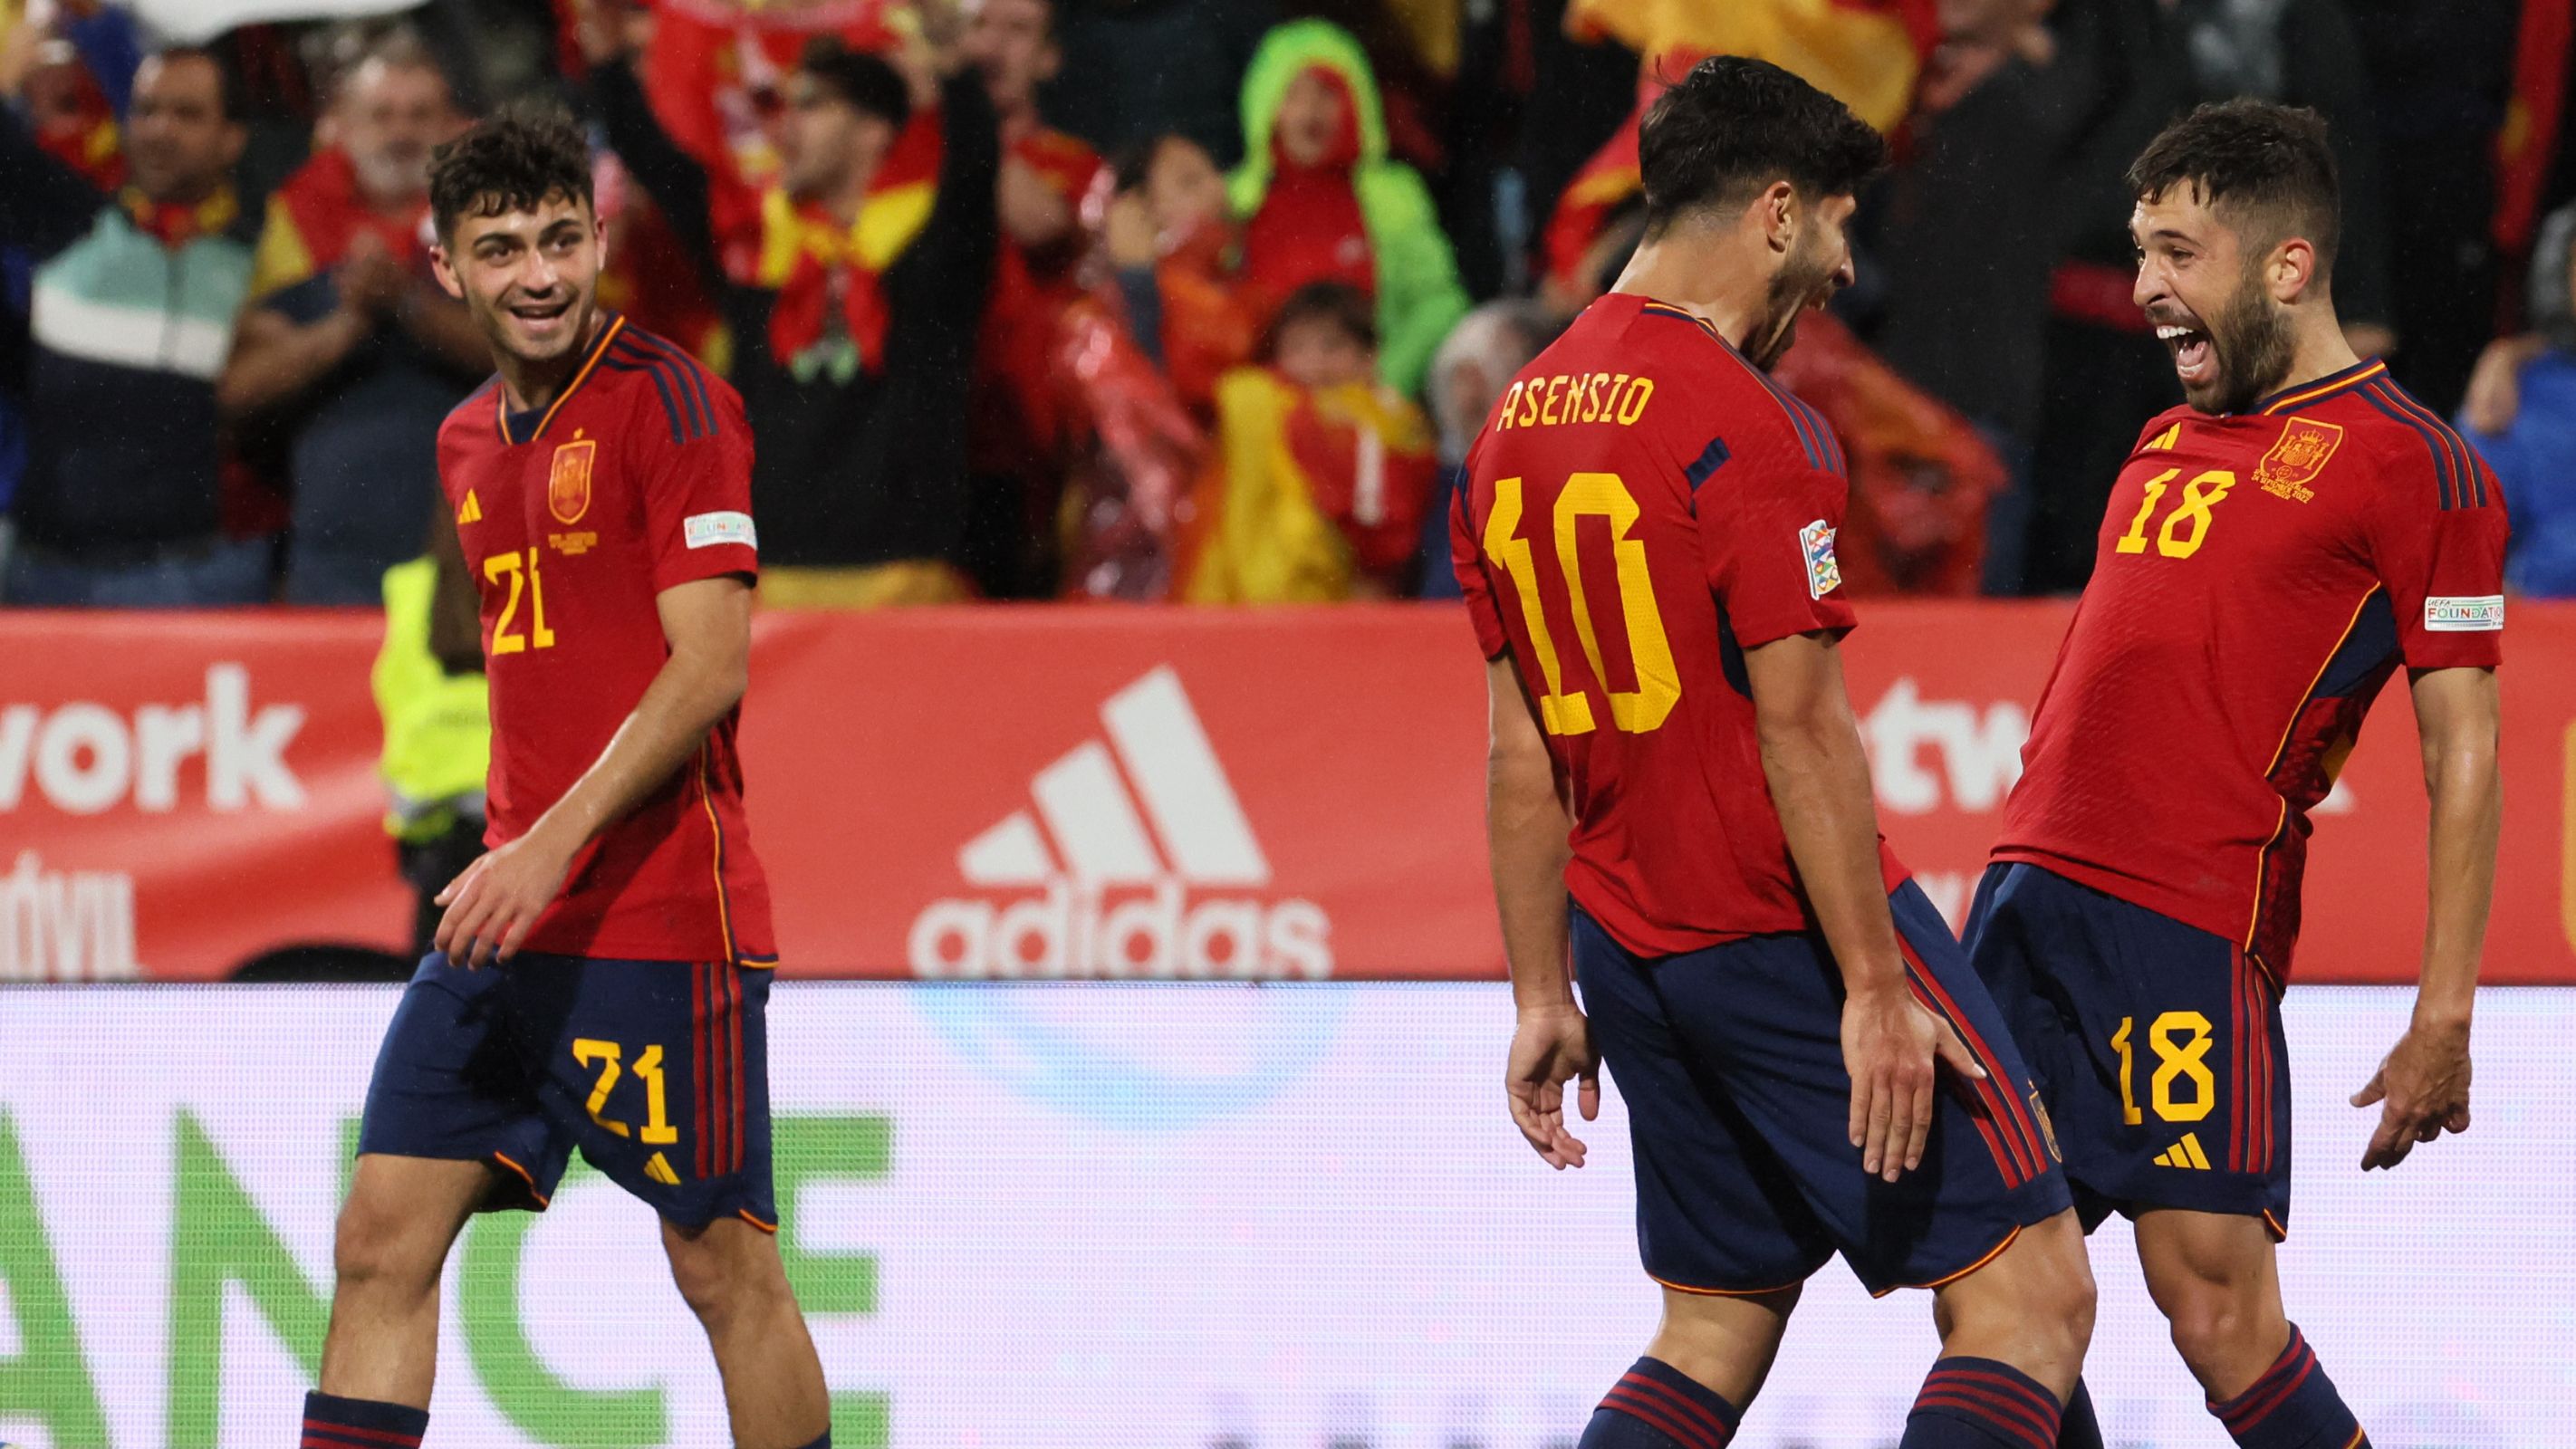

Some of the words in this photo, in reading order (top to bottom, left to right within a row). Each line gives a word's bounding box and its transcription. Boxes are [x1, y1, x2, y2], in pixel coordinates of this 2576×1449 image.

[1495, 372, 1654, 432] ASENSIO
[2115, 468, 2235, 559] 18
[2292, 489, 2311, 504] 2022
[484, 546, 555, 656] 21
[1483, 472, 1682, 736] 10
[2428, 599, 2451, 607] UEFA
[908, 875, 1334, 981] adidas
[572, 1038, 678, 1145] 21
[2110, 1011, 2216, 1126] 18
